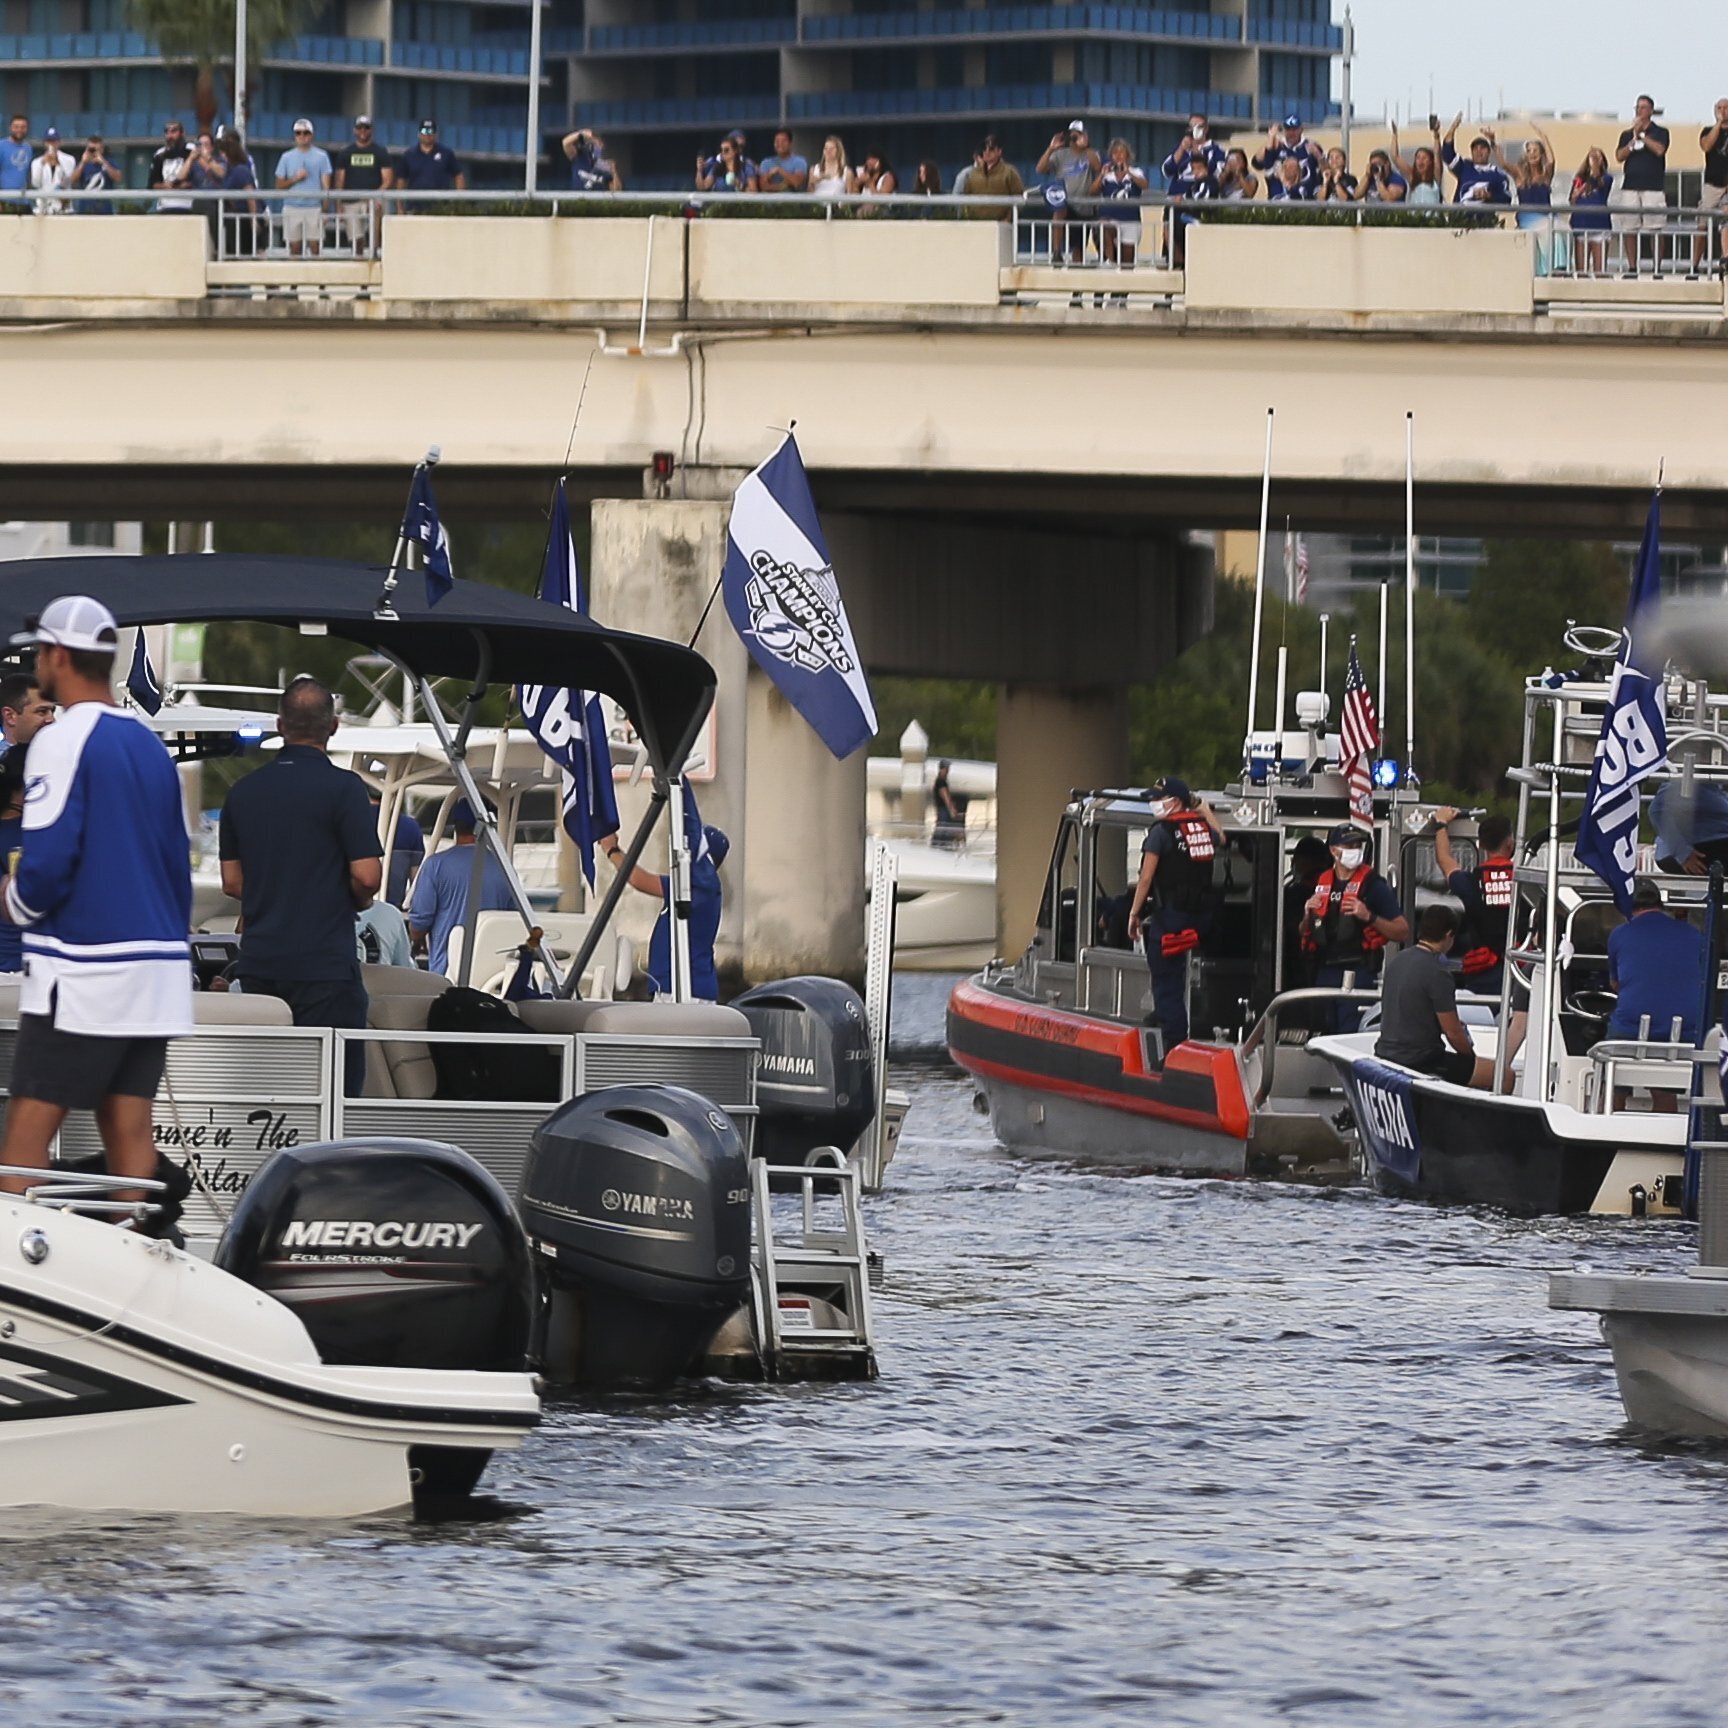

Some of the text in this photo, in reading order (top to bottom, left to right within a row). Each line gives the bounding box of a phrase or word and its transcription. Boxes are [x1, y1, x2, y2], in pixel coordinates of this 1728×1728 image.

[751, 551, 854, 672] CHAMPIONS
[782, 562, 843, 637] STANLEY CUP
[1486, 893, 1511, 905] GUAR
[764, 1055, 815, 1075] YAMAHA
[845, 1049, 870, 1060] 300
[1356, 1078, 1414, 1150] MEDIA
[152, 1108, 300, 1151] ome'n The
[620, 1192, 694, 1220] YAMAHA
[726, 1189, 748, 1204] 90
[282, 1221, 483, 1248] MERCURY
